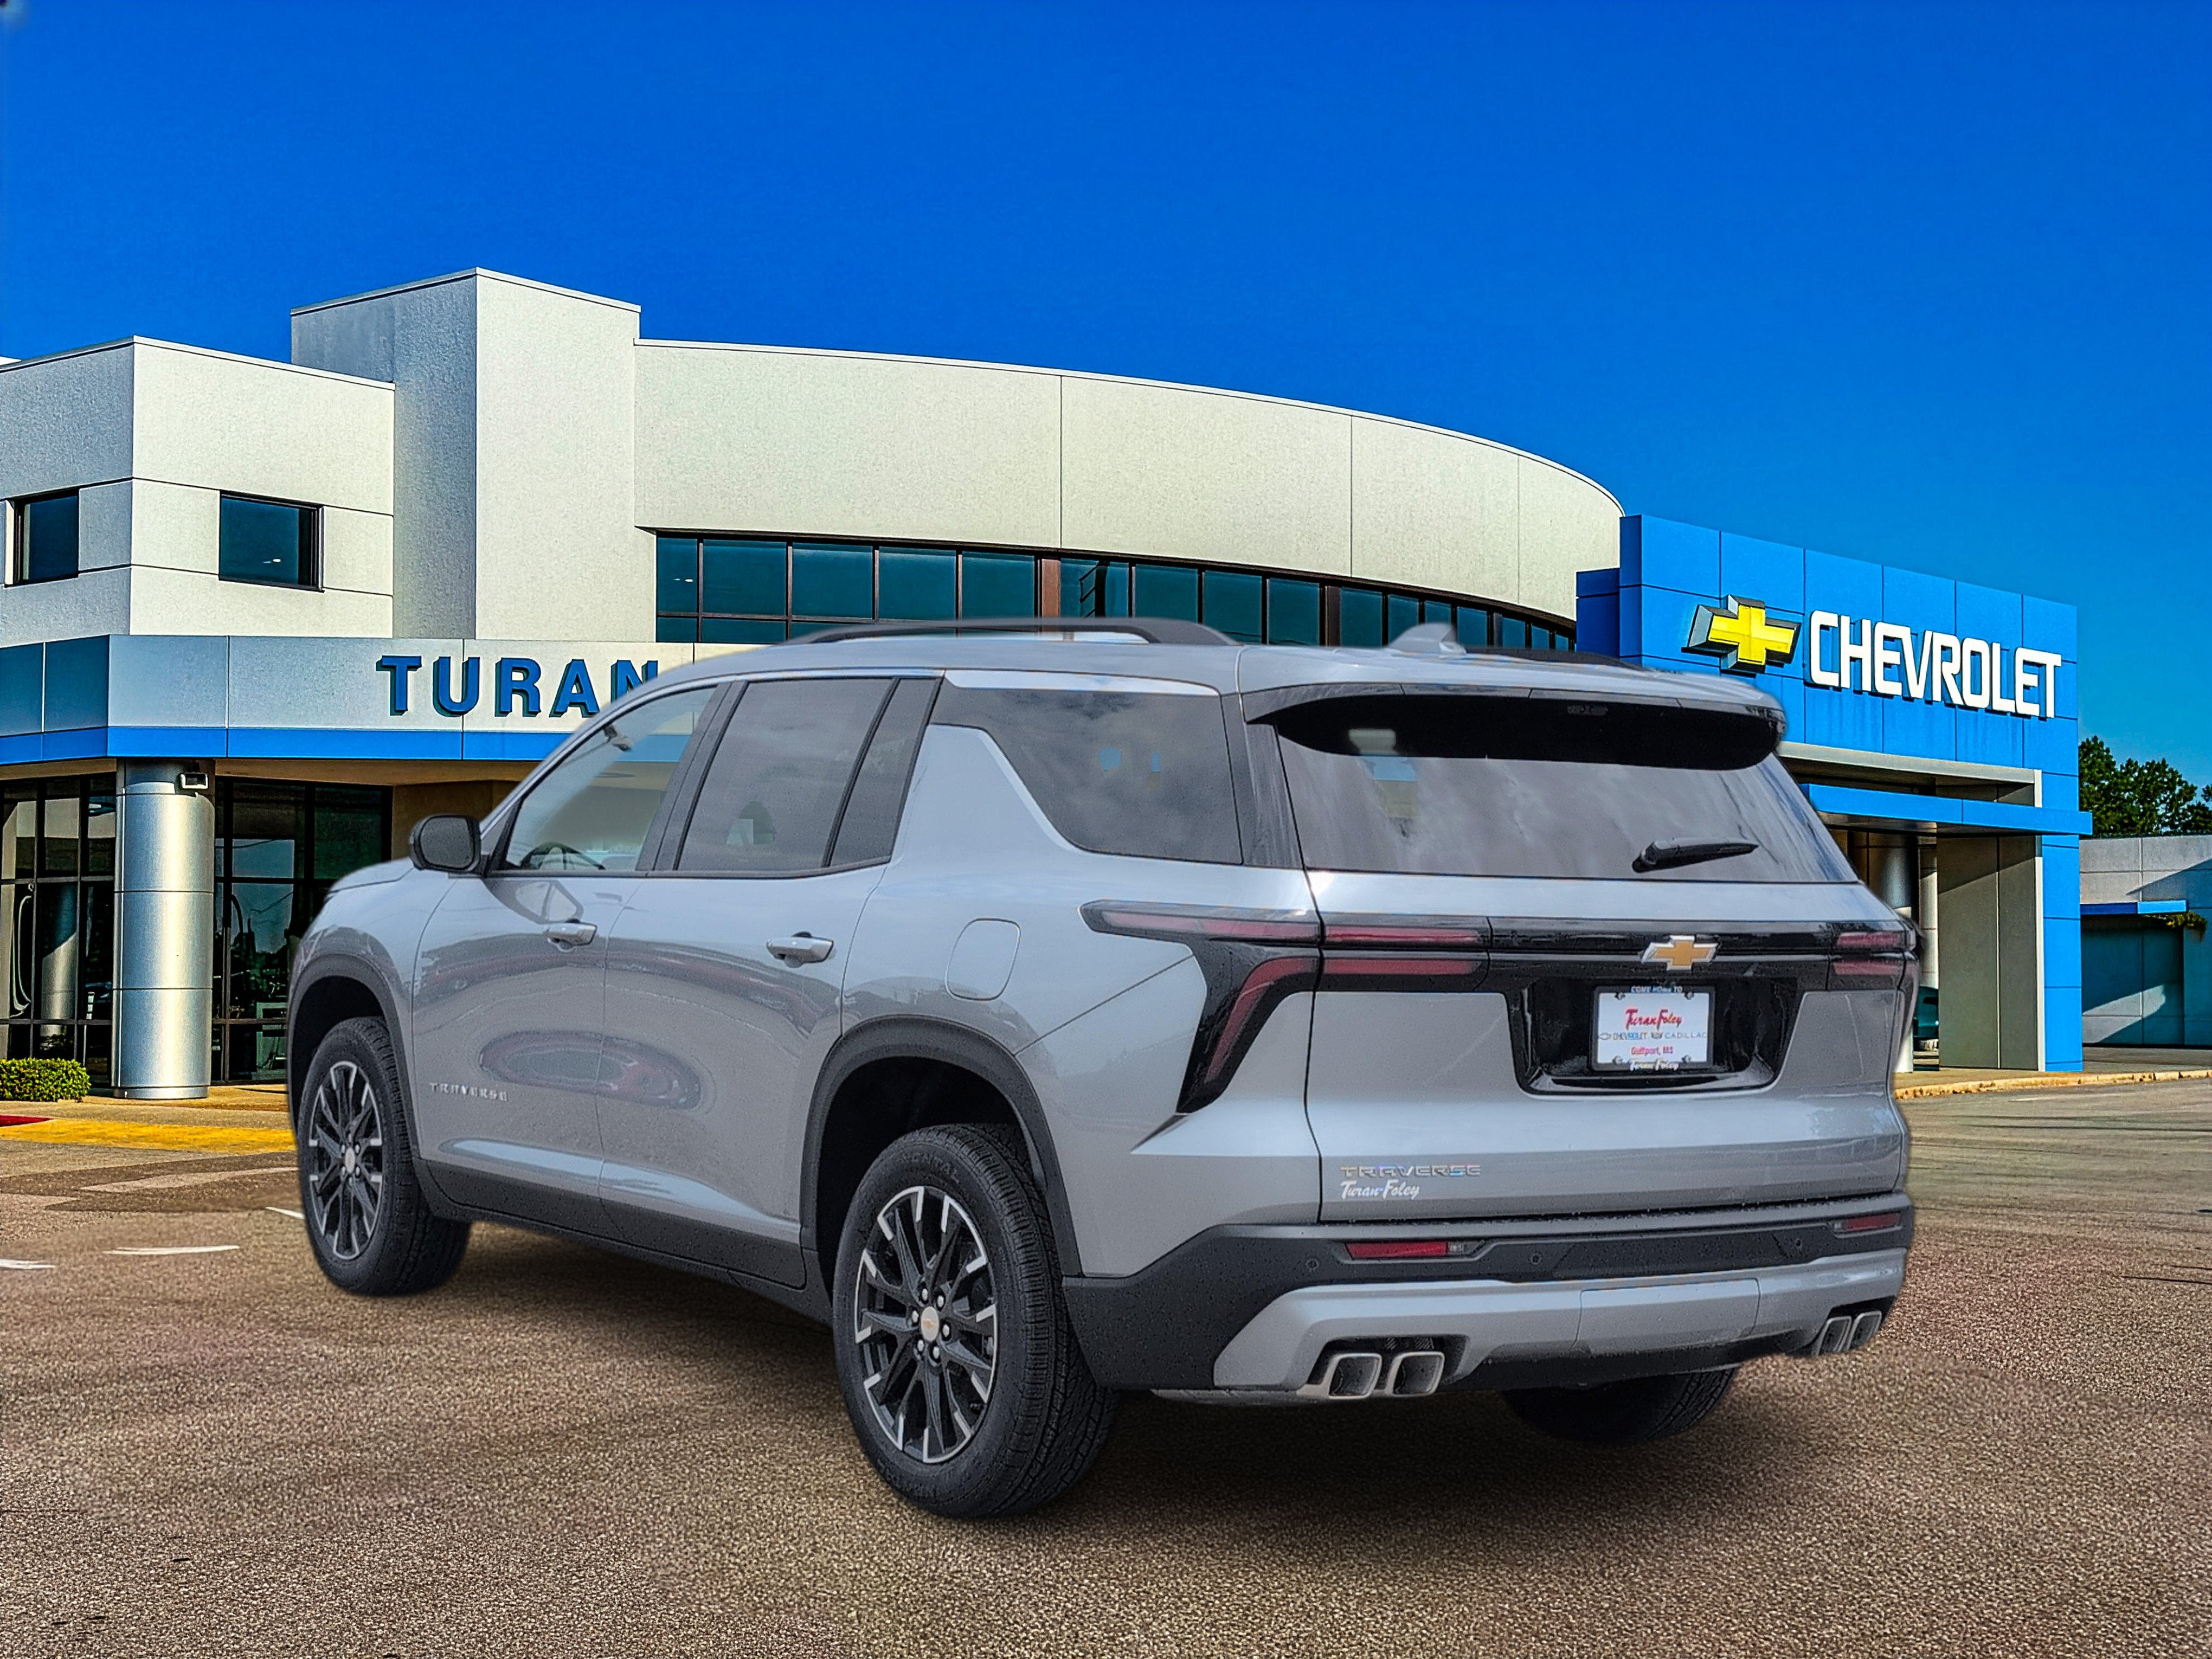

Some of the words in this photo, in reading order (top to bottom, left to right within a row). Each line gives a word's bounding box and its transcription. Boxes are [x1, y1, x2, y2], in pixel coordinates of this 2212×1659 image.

[1810, 610, 2062, 718] CHEVROLET
[376, 655, 659, 718] TURAN
[429, 1083, 508, 1102] TRAVERSE
[1340, 1165, 1482, 1178] TRAVERSE
